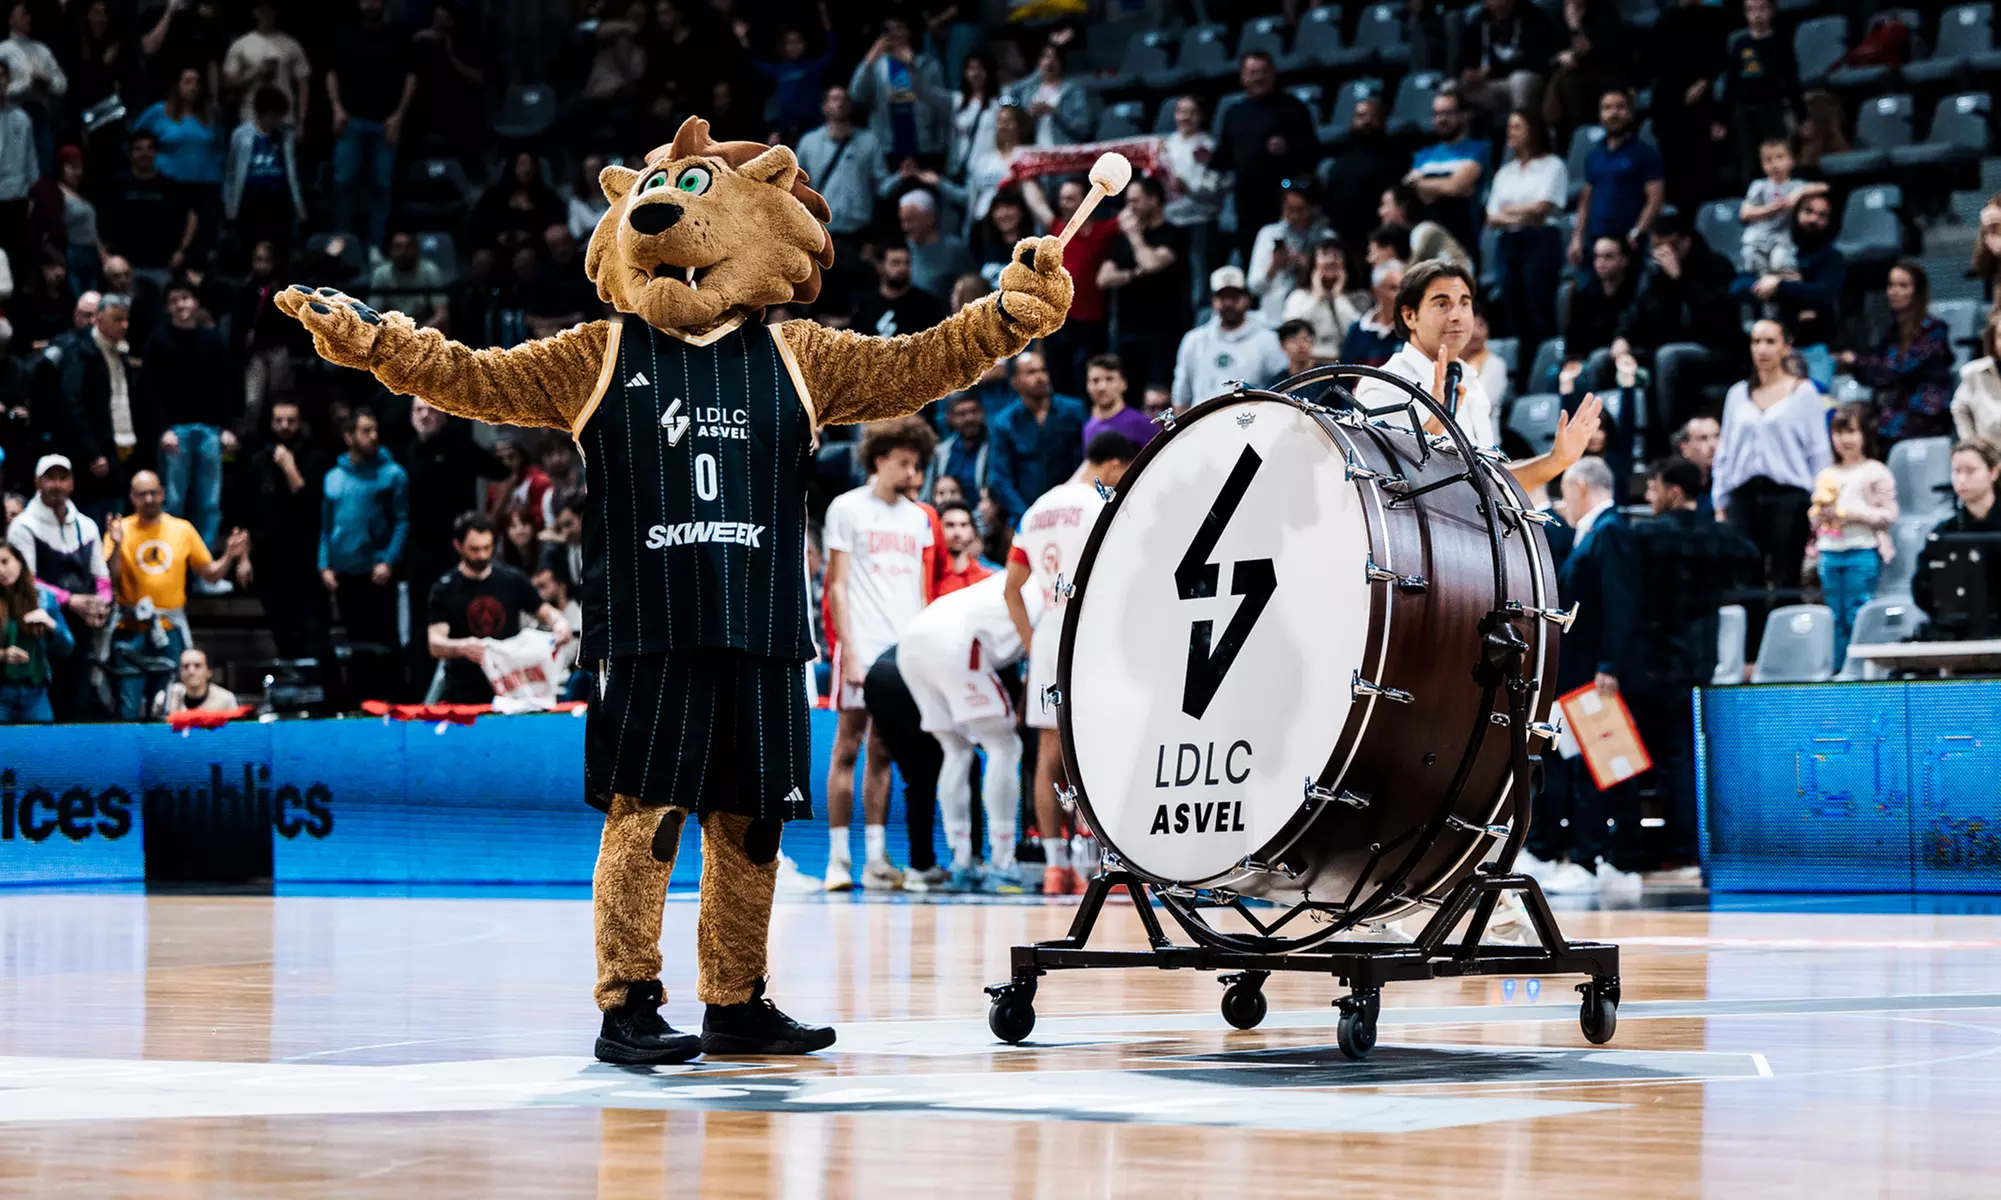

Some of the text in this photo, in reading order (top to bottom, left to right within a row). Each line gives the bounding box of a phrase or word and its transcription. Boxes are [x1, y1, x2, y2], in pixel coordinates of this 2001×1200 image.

[695, 406, 748, 425] LDLC
[697, 425, 748, 440] ASVEL
[694, 452, 718, 502] 0
[645, 521, 766, 550] SKWEEK
[1155, 739, 1253, 788] LDLC
[0, 767, 133, 842] ices
[1149, 800, 1246, 835] ASVEL
